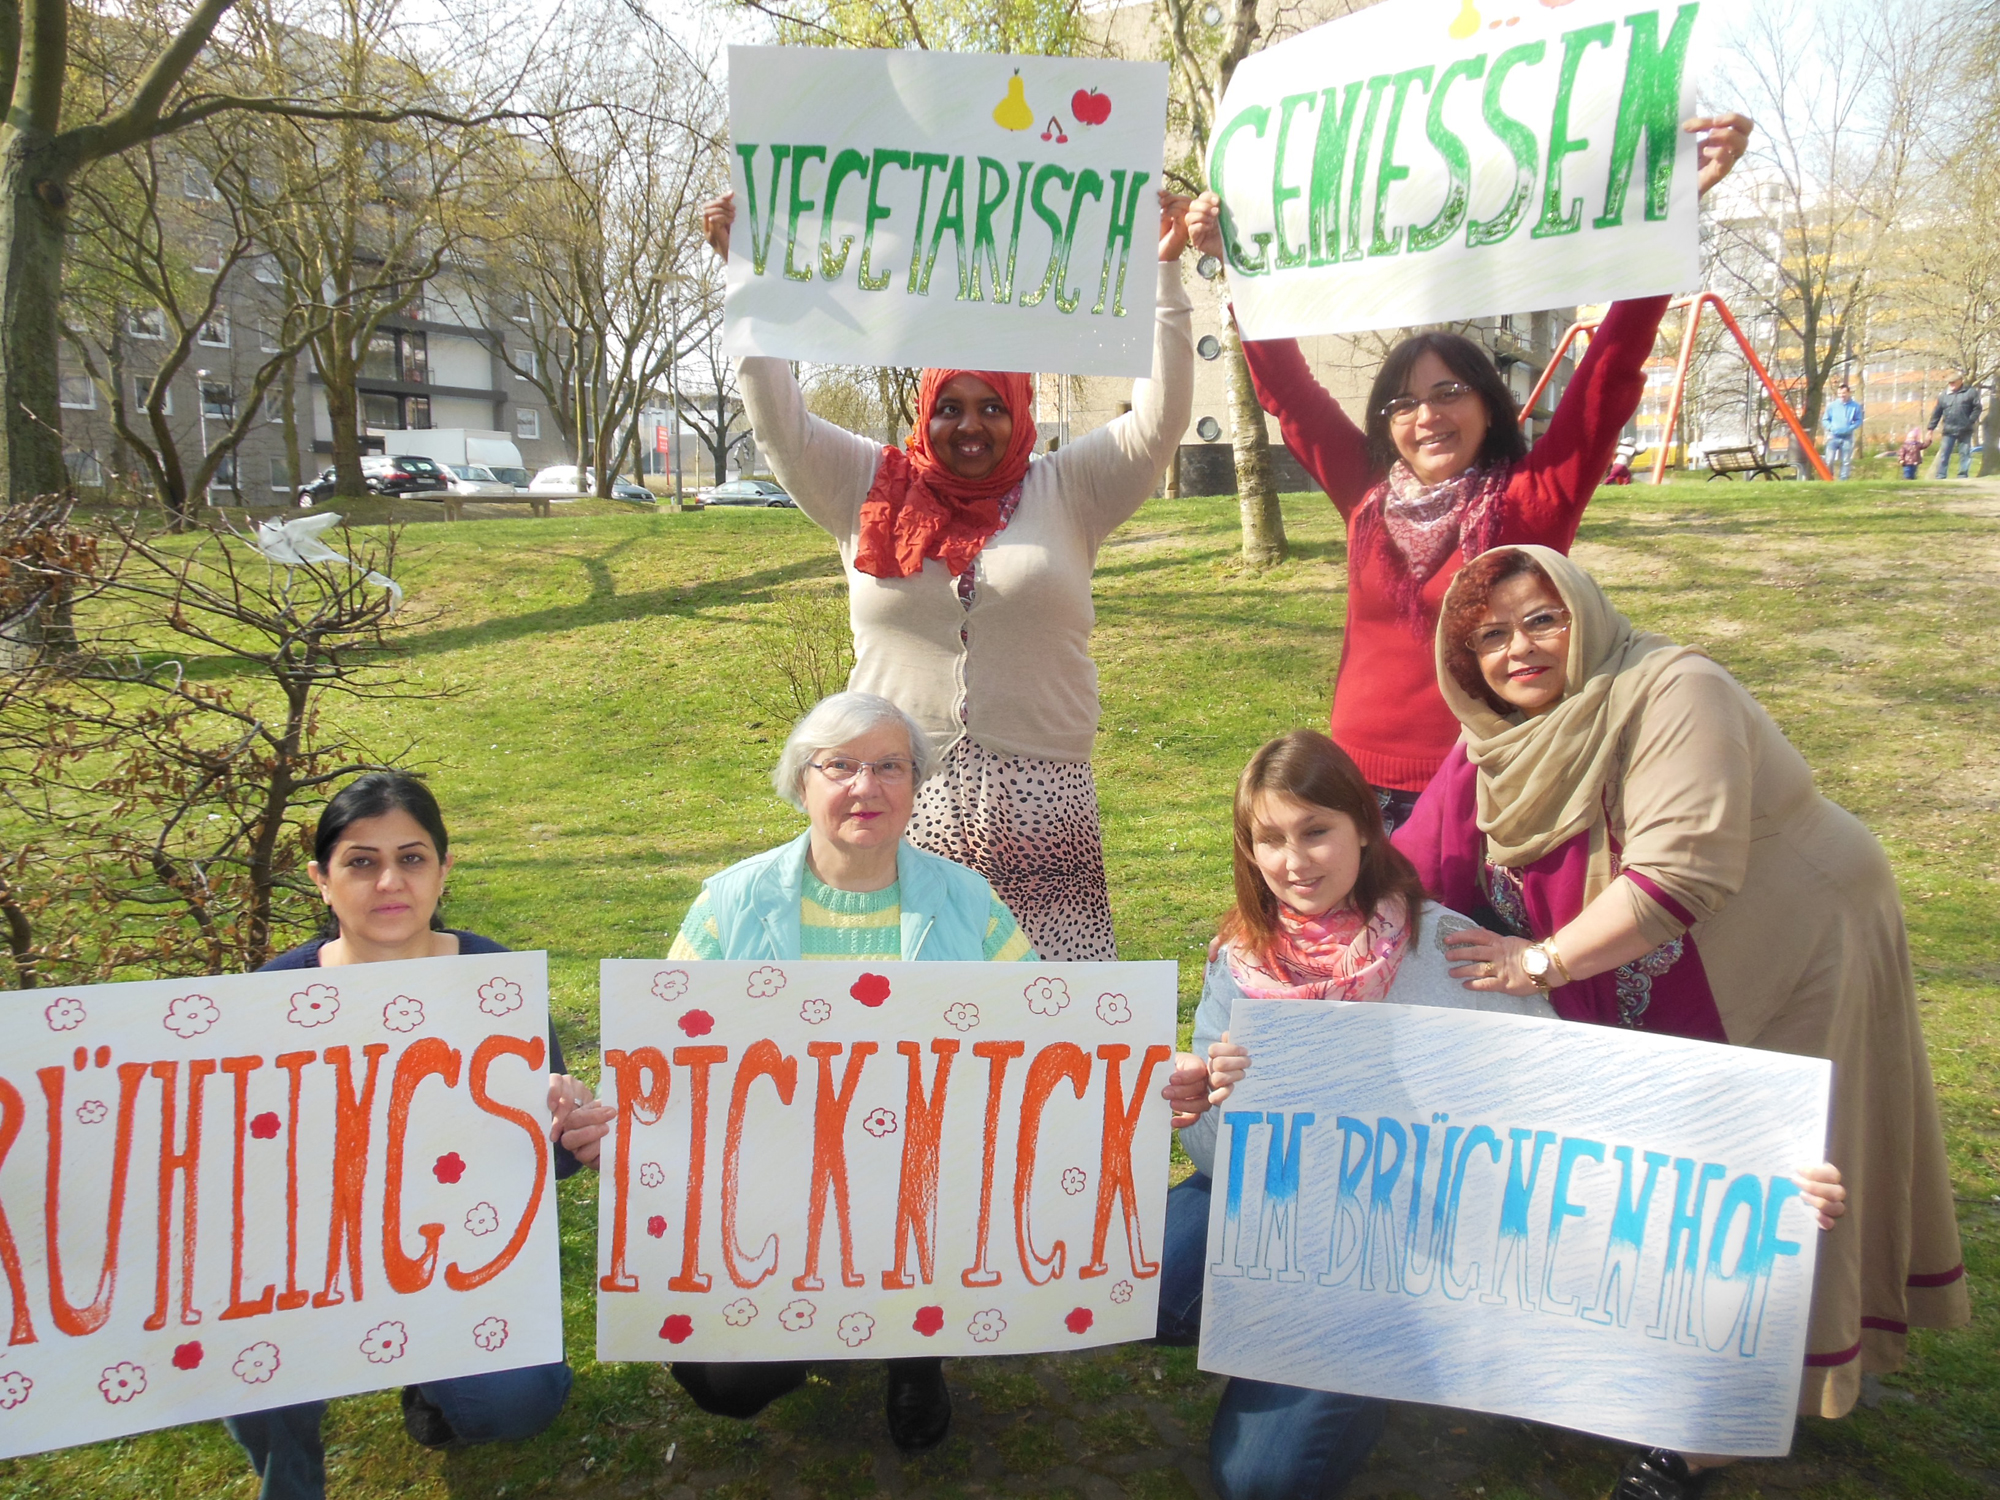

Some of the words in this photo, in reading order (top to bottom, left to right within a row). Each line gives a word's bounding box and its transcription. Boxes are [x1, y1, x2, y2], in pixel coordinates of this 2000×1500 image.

[735, 143, 1150, 318] VEGETARISCH
[1209, 2, 1700, 278] GENIESSEN
[599, 1037, 1172, 1293] PICKNICK
[1209, 1110, 1315, 1283] IM
[1317, 1111, 1803, 1358] BRÜCKENHOF
